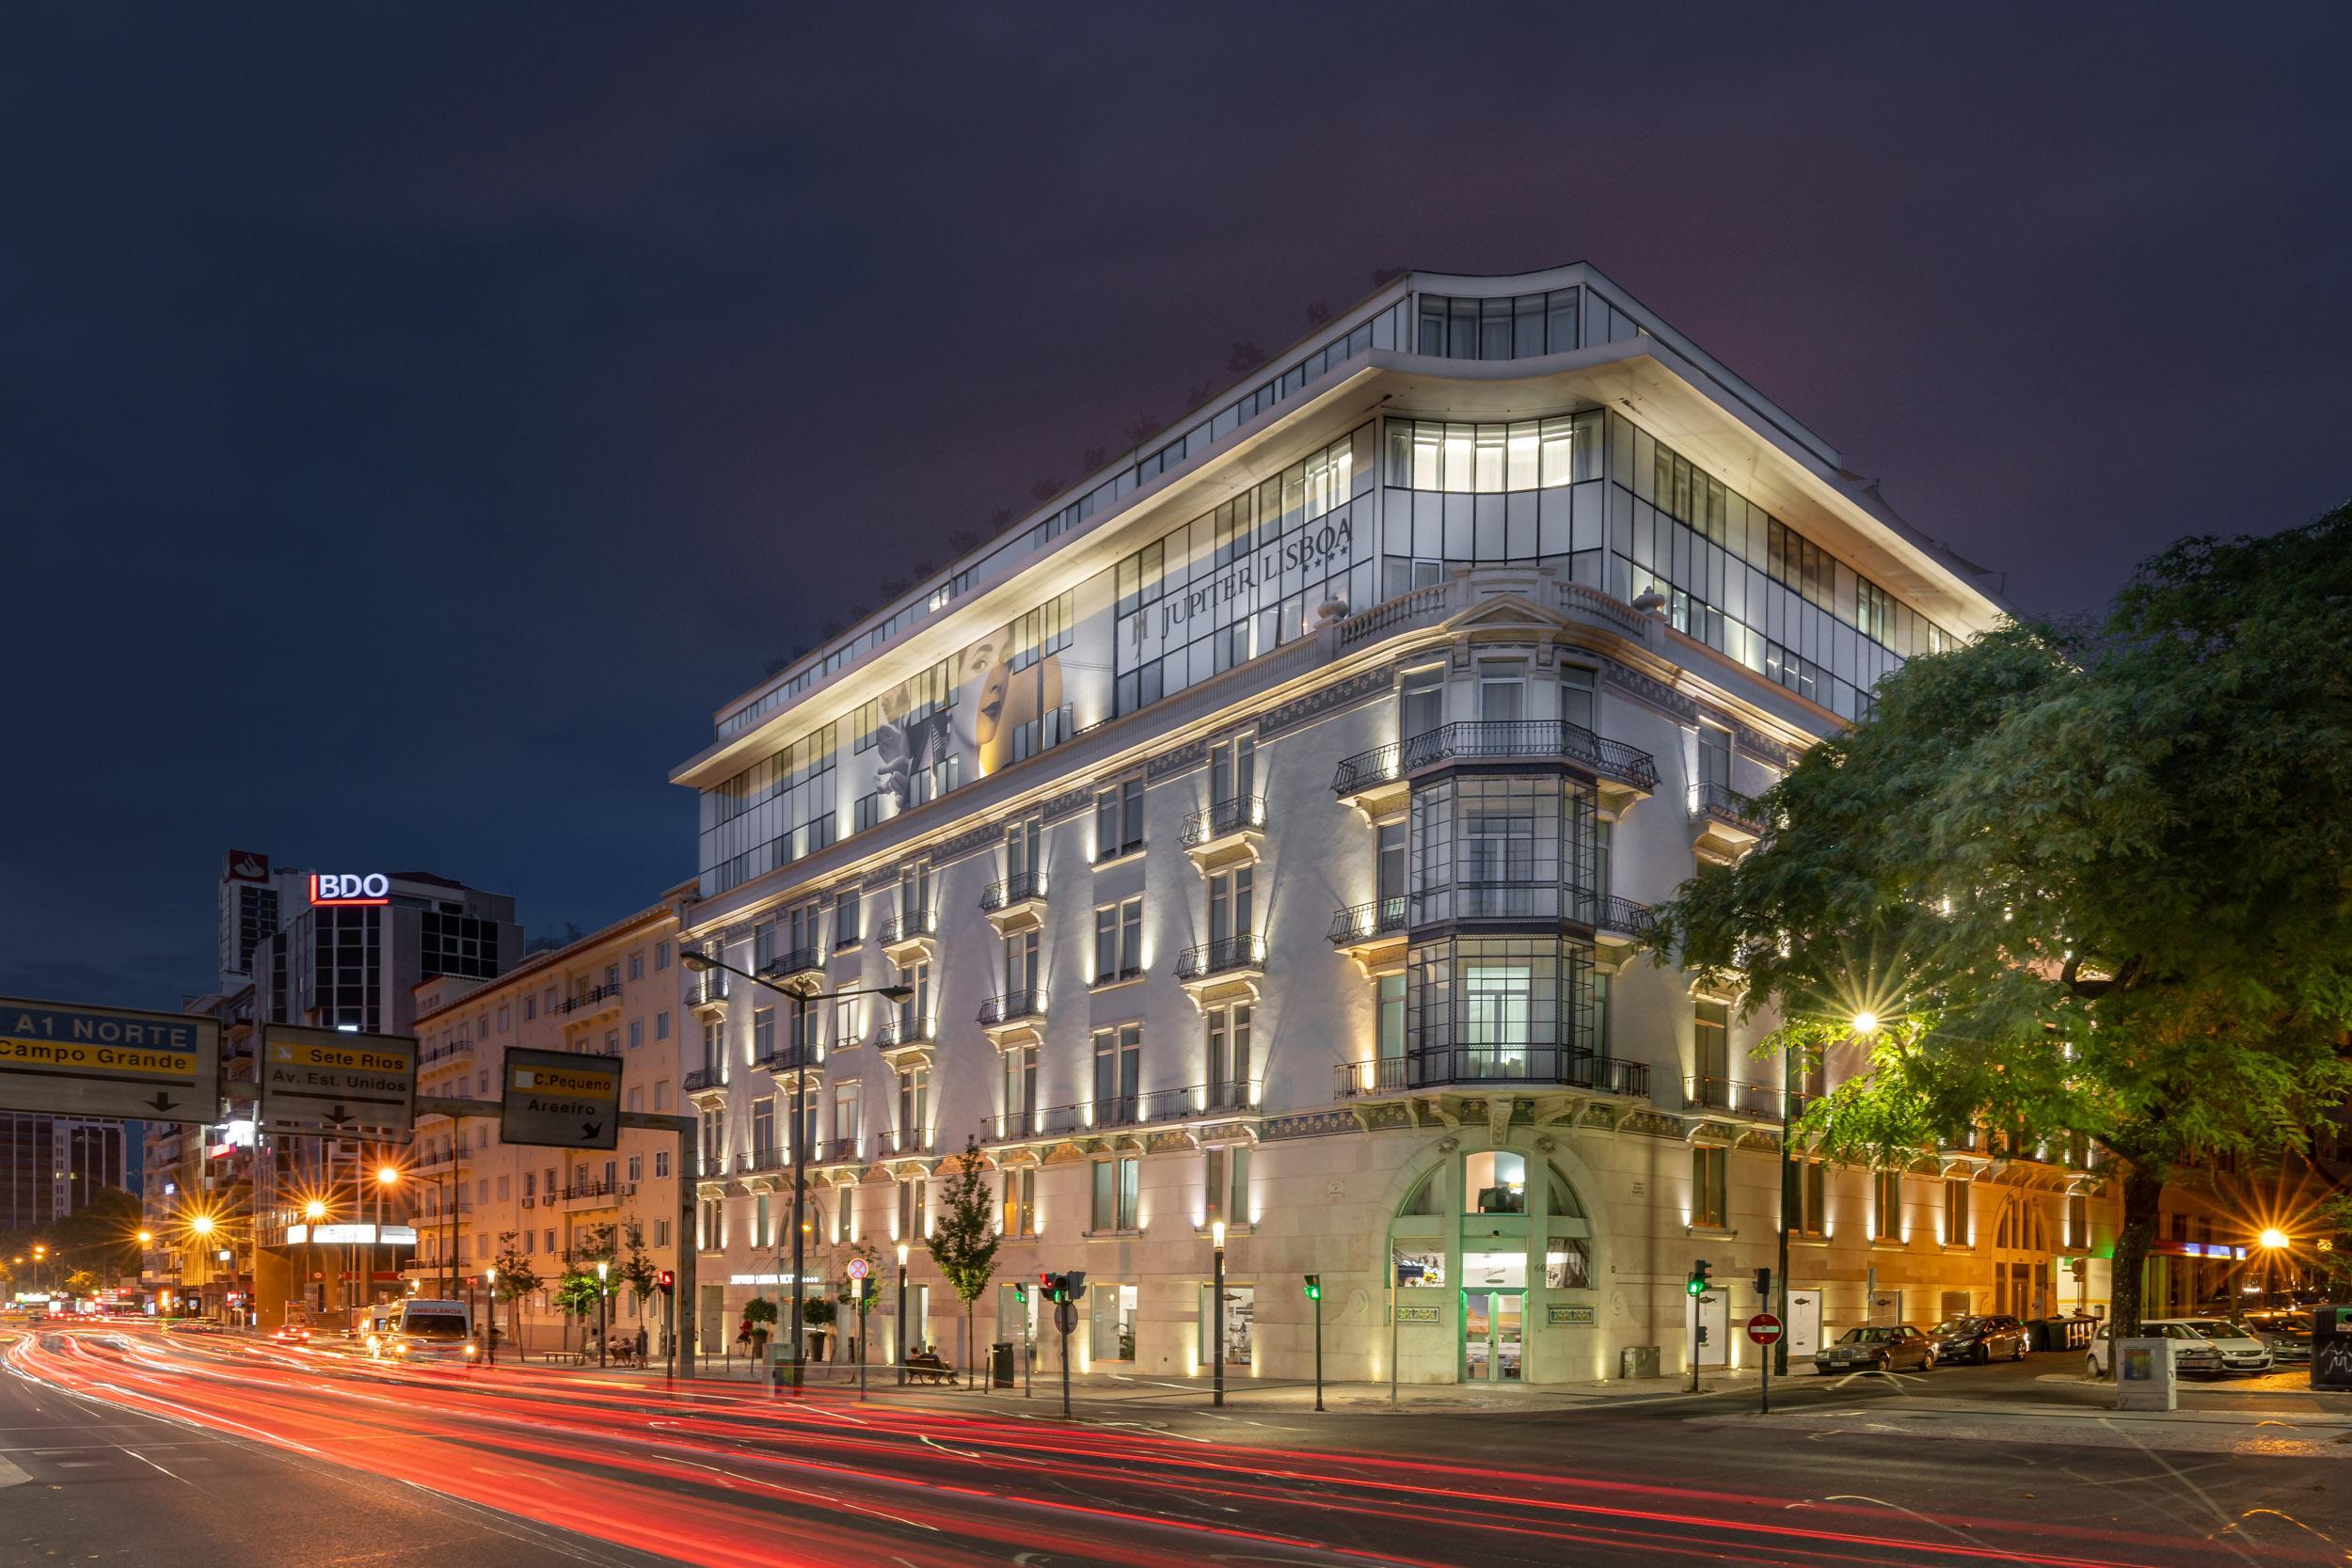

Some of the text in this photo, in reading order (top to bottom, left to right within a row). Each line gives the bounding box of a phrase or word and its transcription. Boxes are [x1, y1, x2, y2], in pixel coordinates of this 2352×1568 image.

[1161, 517, 1353, 640] JUPITER LISBOA
[319, 873, 389, 898] BDO
[14, 1014, 187, 1047] A1 NORTE
[0, 1039, 186, 1069] Campo Grande
[310, 1050, 405, 1070] Sete Rios
[272, 1069, 406, 1093] Av. Est. Unidos
[528, 1099, 596, 1116] Areeiro
